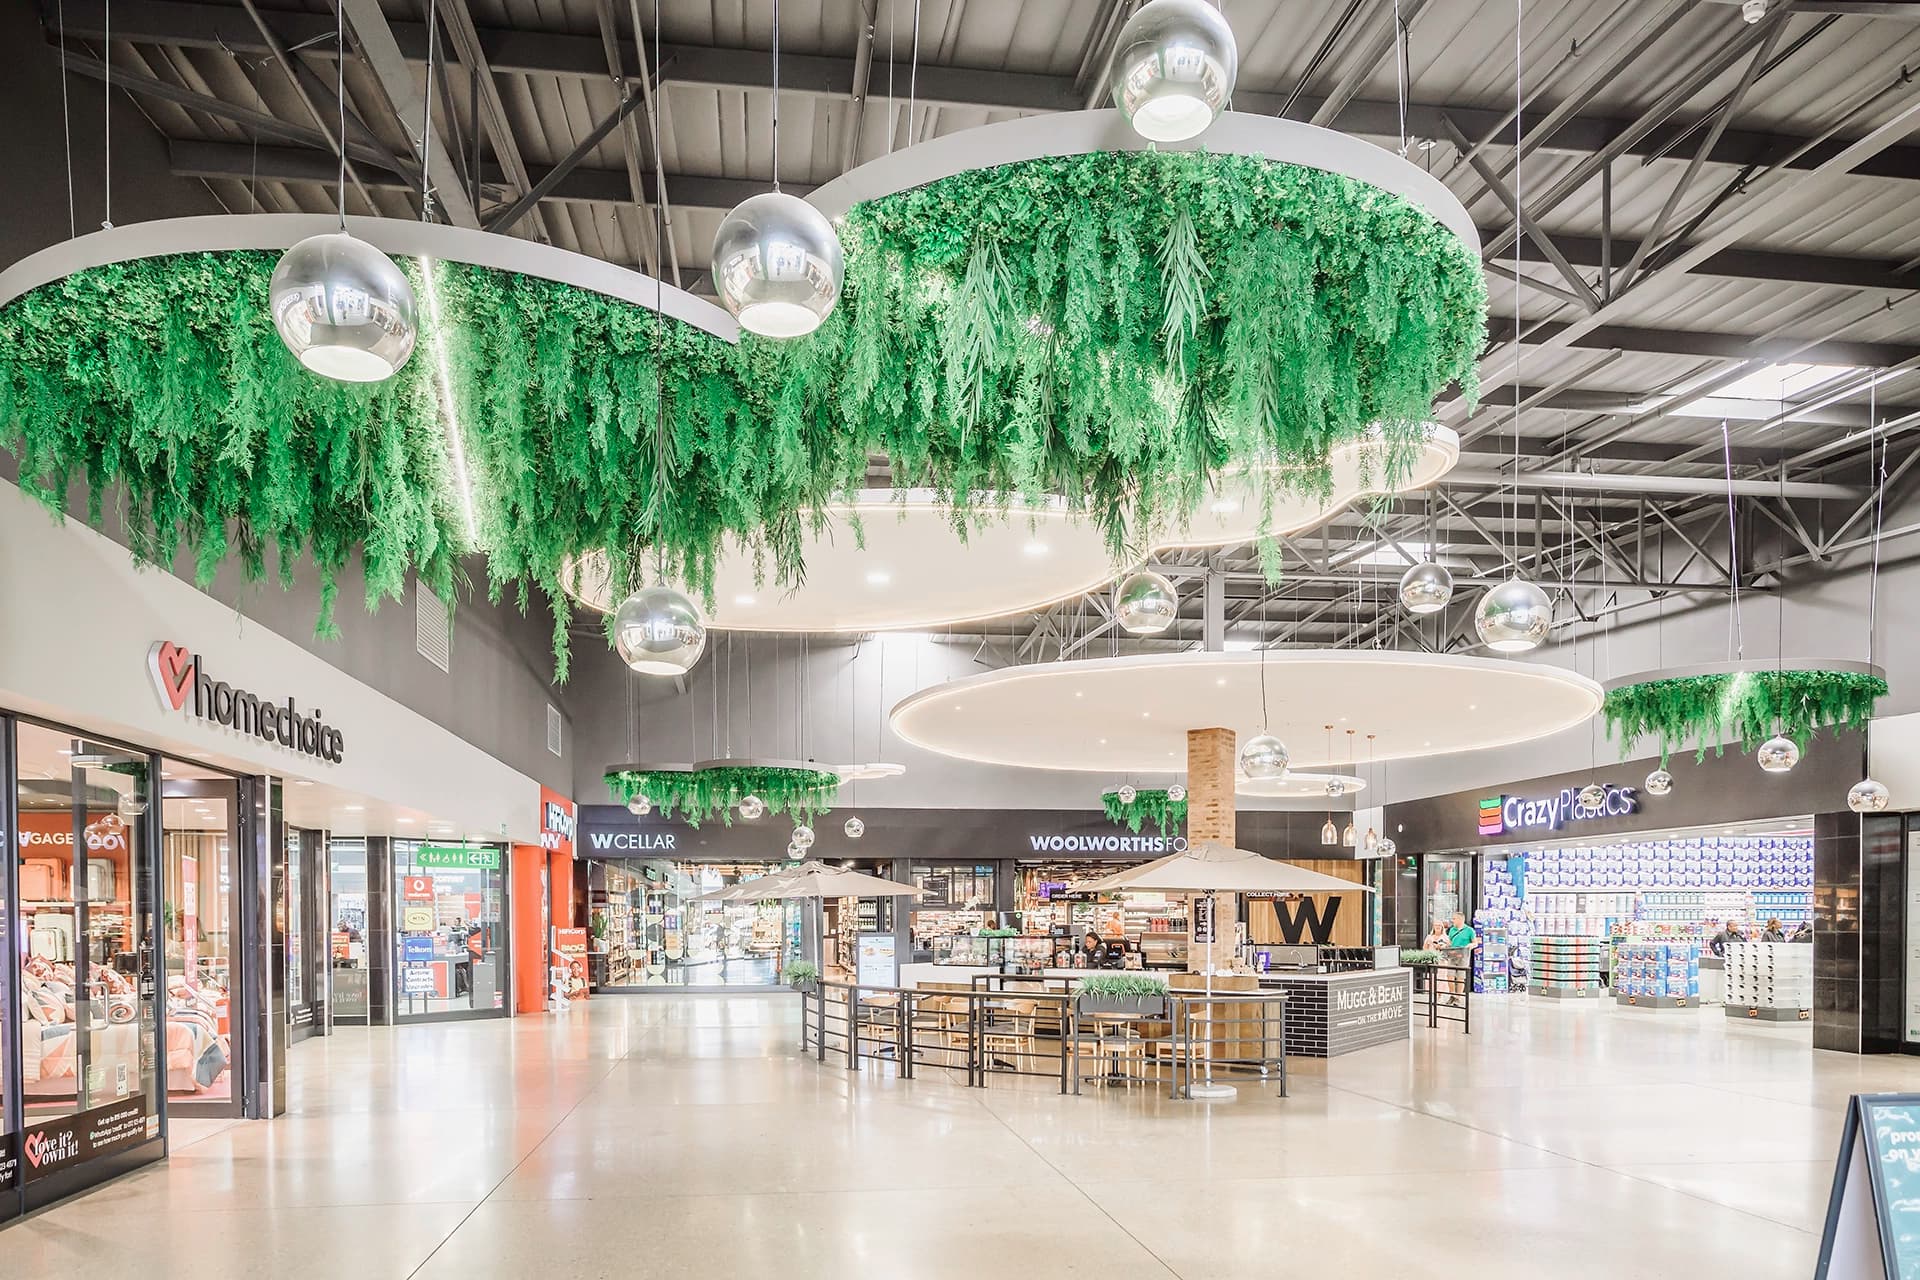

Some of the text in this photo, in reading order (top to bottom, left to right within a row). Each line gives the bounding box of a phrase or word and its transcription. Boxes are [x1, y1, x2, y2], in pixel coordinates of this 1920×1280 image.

[193, 654, 344, 764] homechoice
[1272, 896, 1342, 944] W
[1337, 986, 1402, 1011] MUGG & BEAN
[1382, 1006, 1402, 1020] MOVE
[42, 1139, 79, 1166] own it!
[59, 1130, 74, 1149] it?
